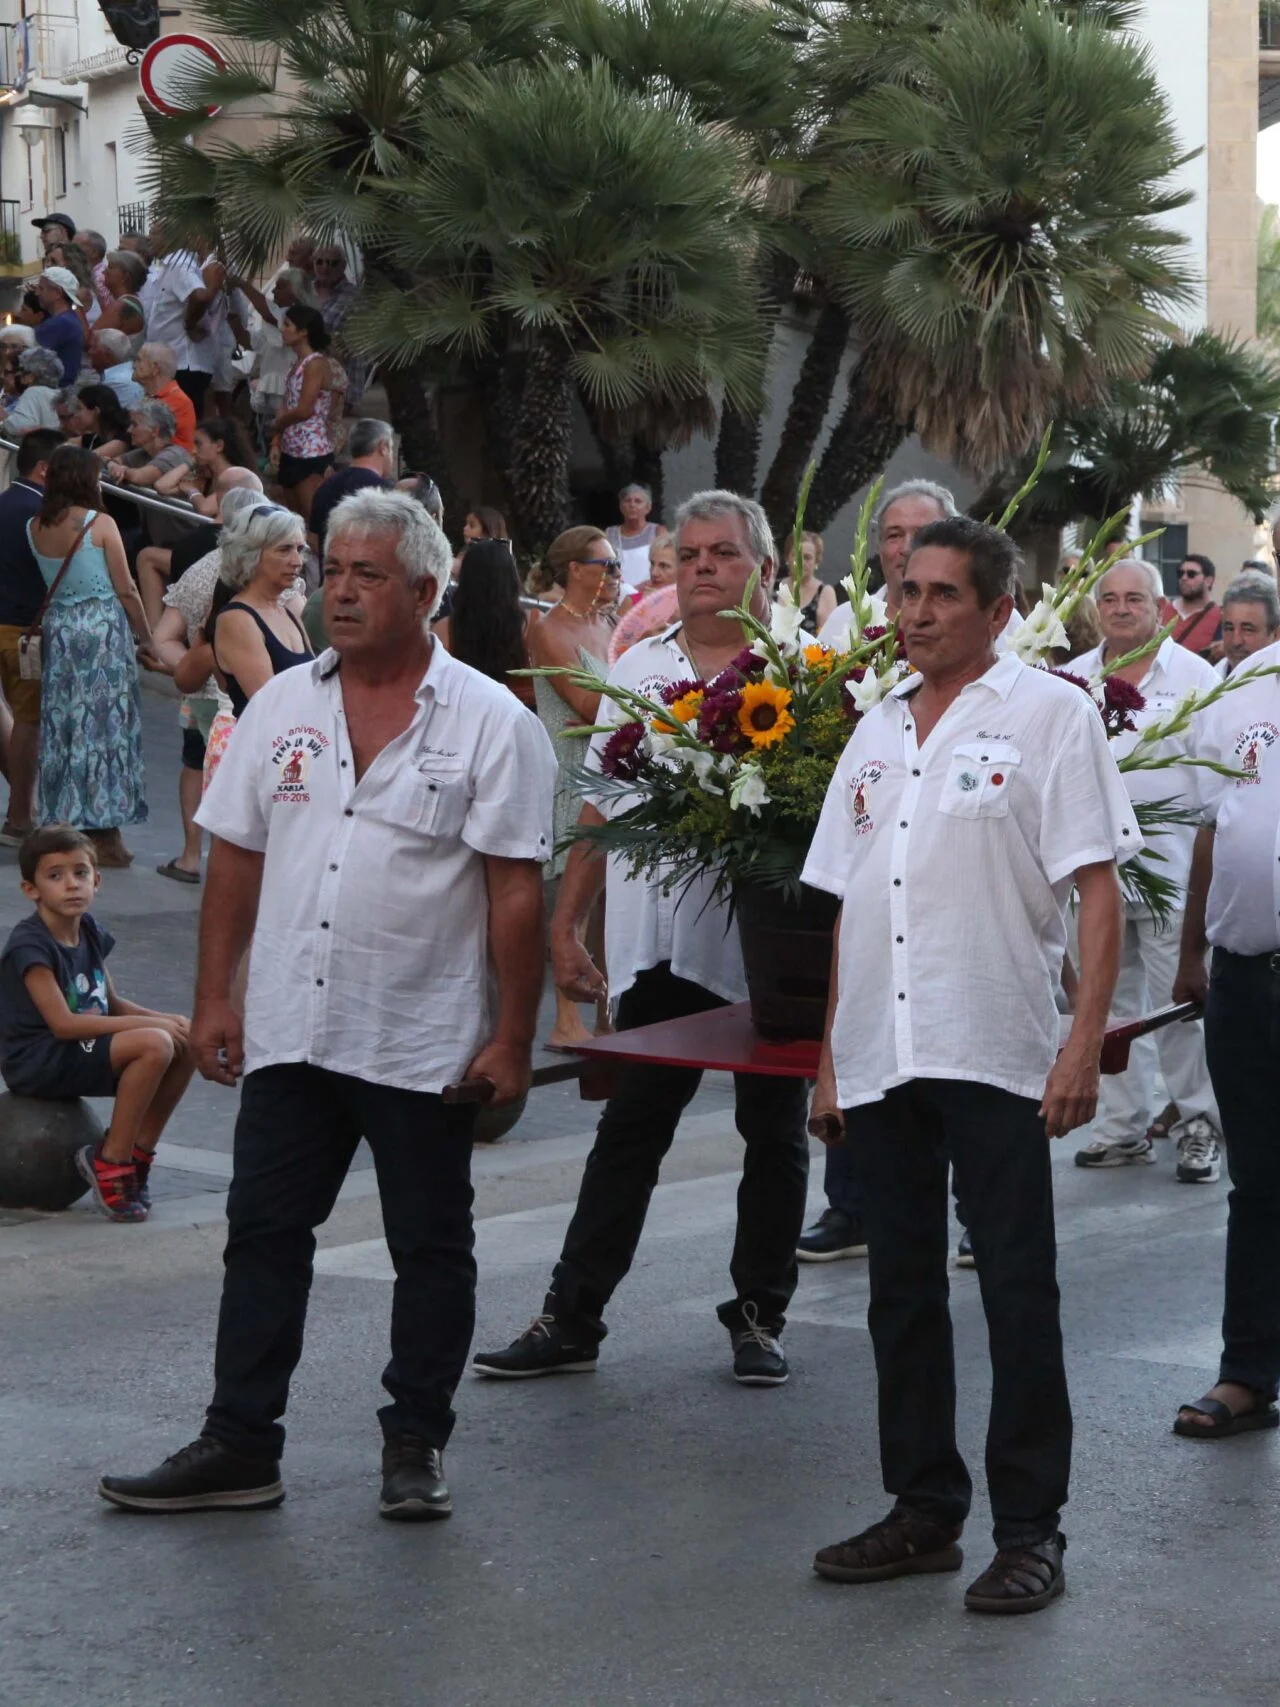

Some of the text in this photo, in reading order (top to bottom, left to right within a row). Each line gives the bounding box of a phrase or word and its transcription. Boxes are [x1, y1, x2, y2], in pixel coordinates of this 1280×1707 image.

[272, 724, 331, 749] 40 aniversari
[271, 737, 324, 765] PEÑA LA BUFA
[277, 784, 305, 792] XABIA
